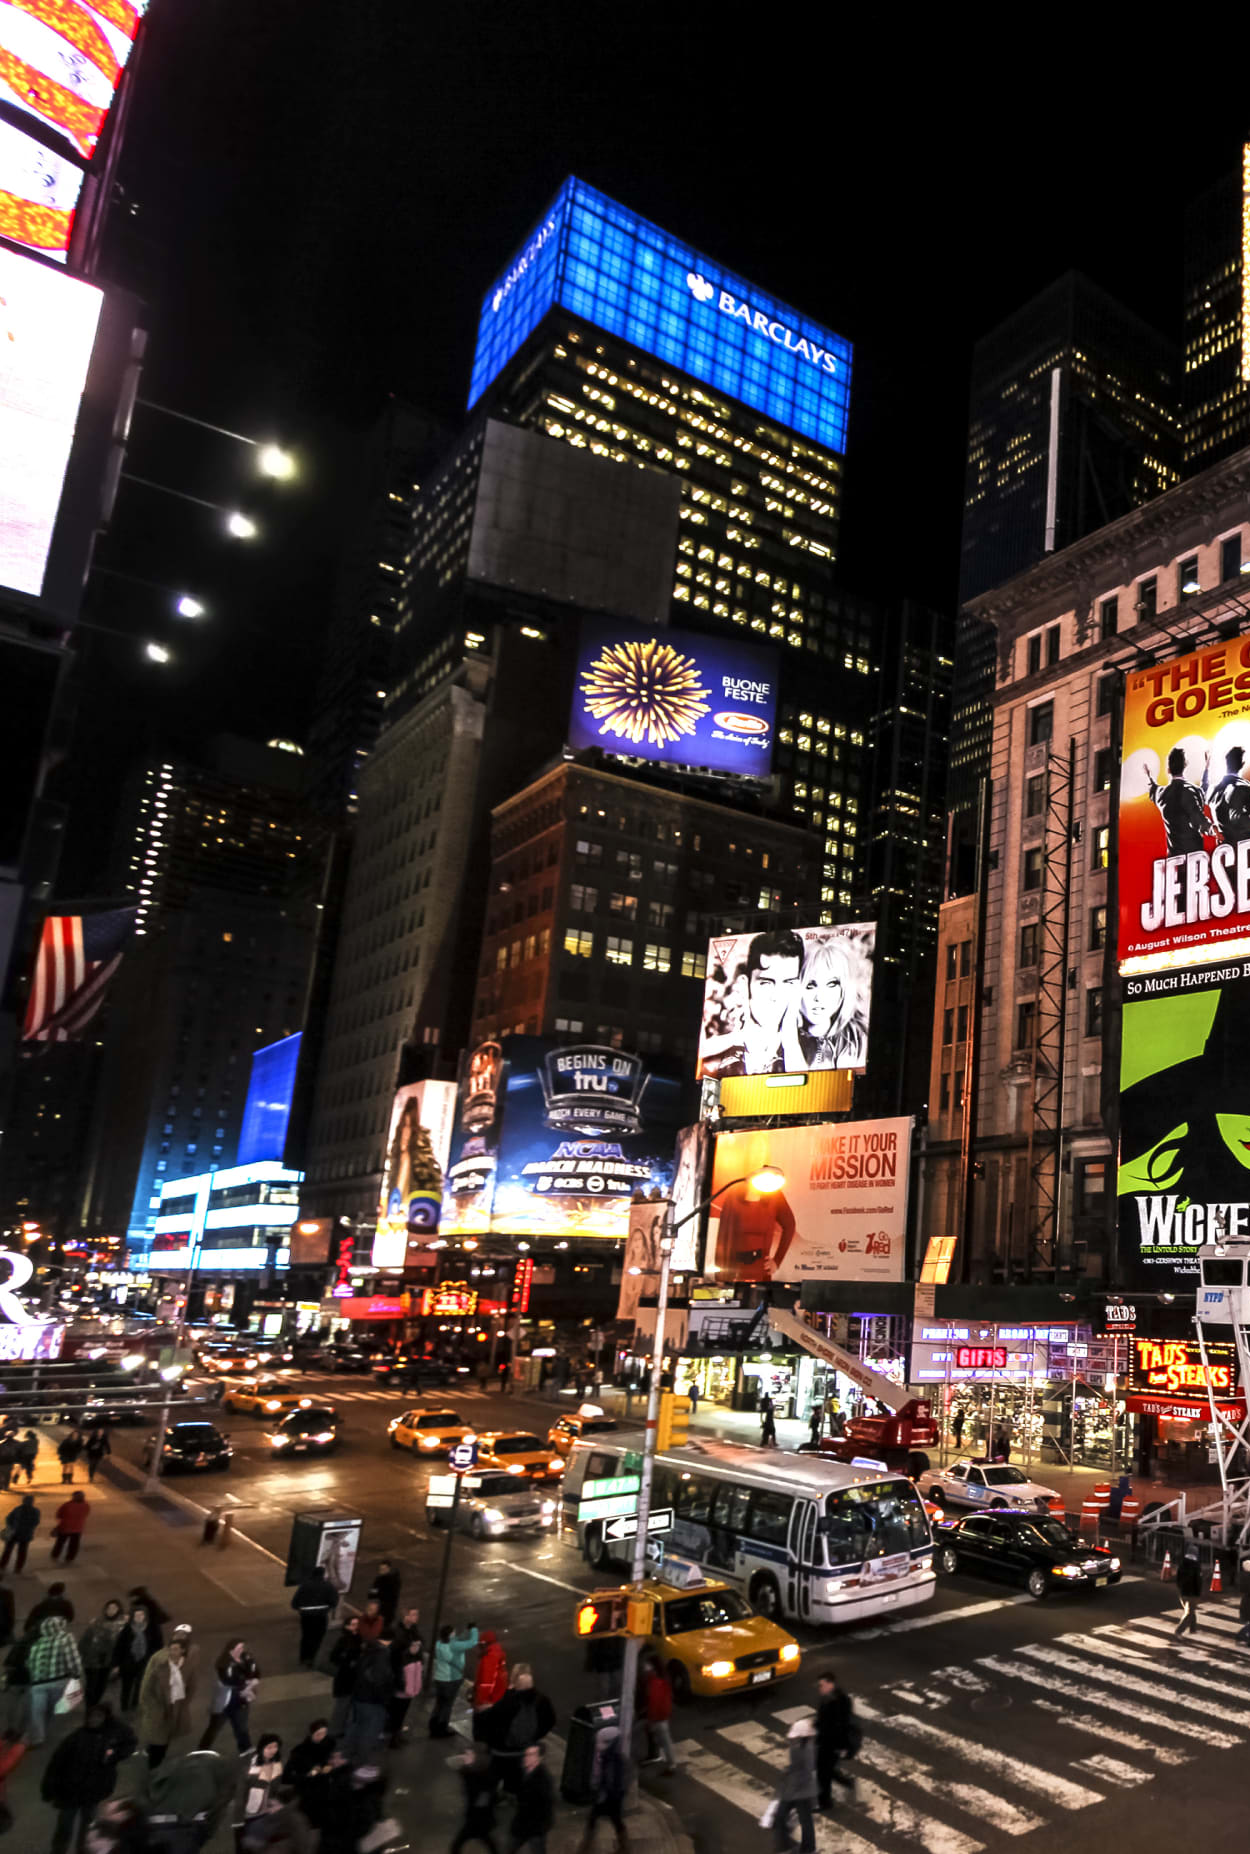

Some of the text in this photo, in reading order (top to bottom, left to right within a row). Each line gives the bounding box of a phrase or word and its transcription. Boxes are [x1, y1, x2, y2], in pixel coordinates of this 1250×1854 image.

[718, 290, 837, 374] BARCLAYS
[721, 676, 771, 695] BUONE
[1135, 936, 1171, 951] August
[1172, 930, 1207, 946] Wilson
[1127, 981, 1143, 996] SO
[1144, 976, 1178, 994] MUCH
[1180, 967, 1241, 989] HAPPENED
[557, 1054, 632, 1077] BEGINS ON
[573, 1108, 601, 1119] EVERY
[604, 1110, 626, 1122] GAME
[551, 1140, 625, 1160] NCAA
[848, 1134, 861, 1154] IT
[863, 1131, 898, 1153] YOUR
[522, 1160, 652, 1179] MARCH MADNESS
[809, 1152, 897, 1181] MISSION
[875, 1178, 896, 1188] WOMEN
[1140, 1245, 1198, 1254] THE UNTOLD STORY
[1203, 1291, 1225, 1303] NYPD
[958, 1348, 1007, 1368] GIFTS
[1137, 1341, 1189, 1371] TAD'S
[1166, 1364, 1231, 1391] STEAKS
[1172, 1406, 1202, 1418] STEAKS
